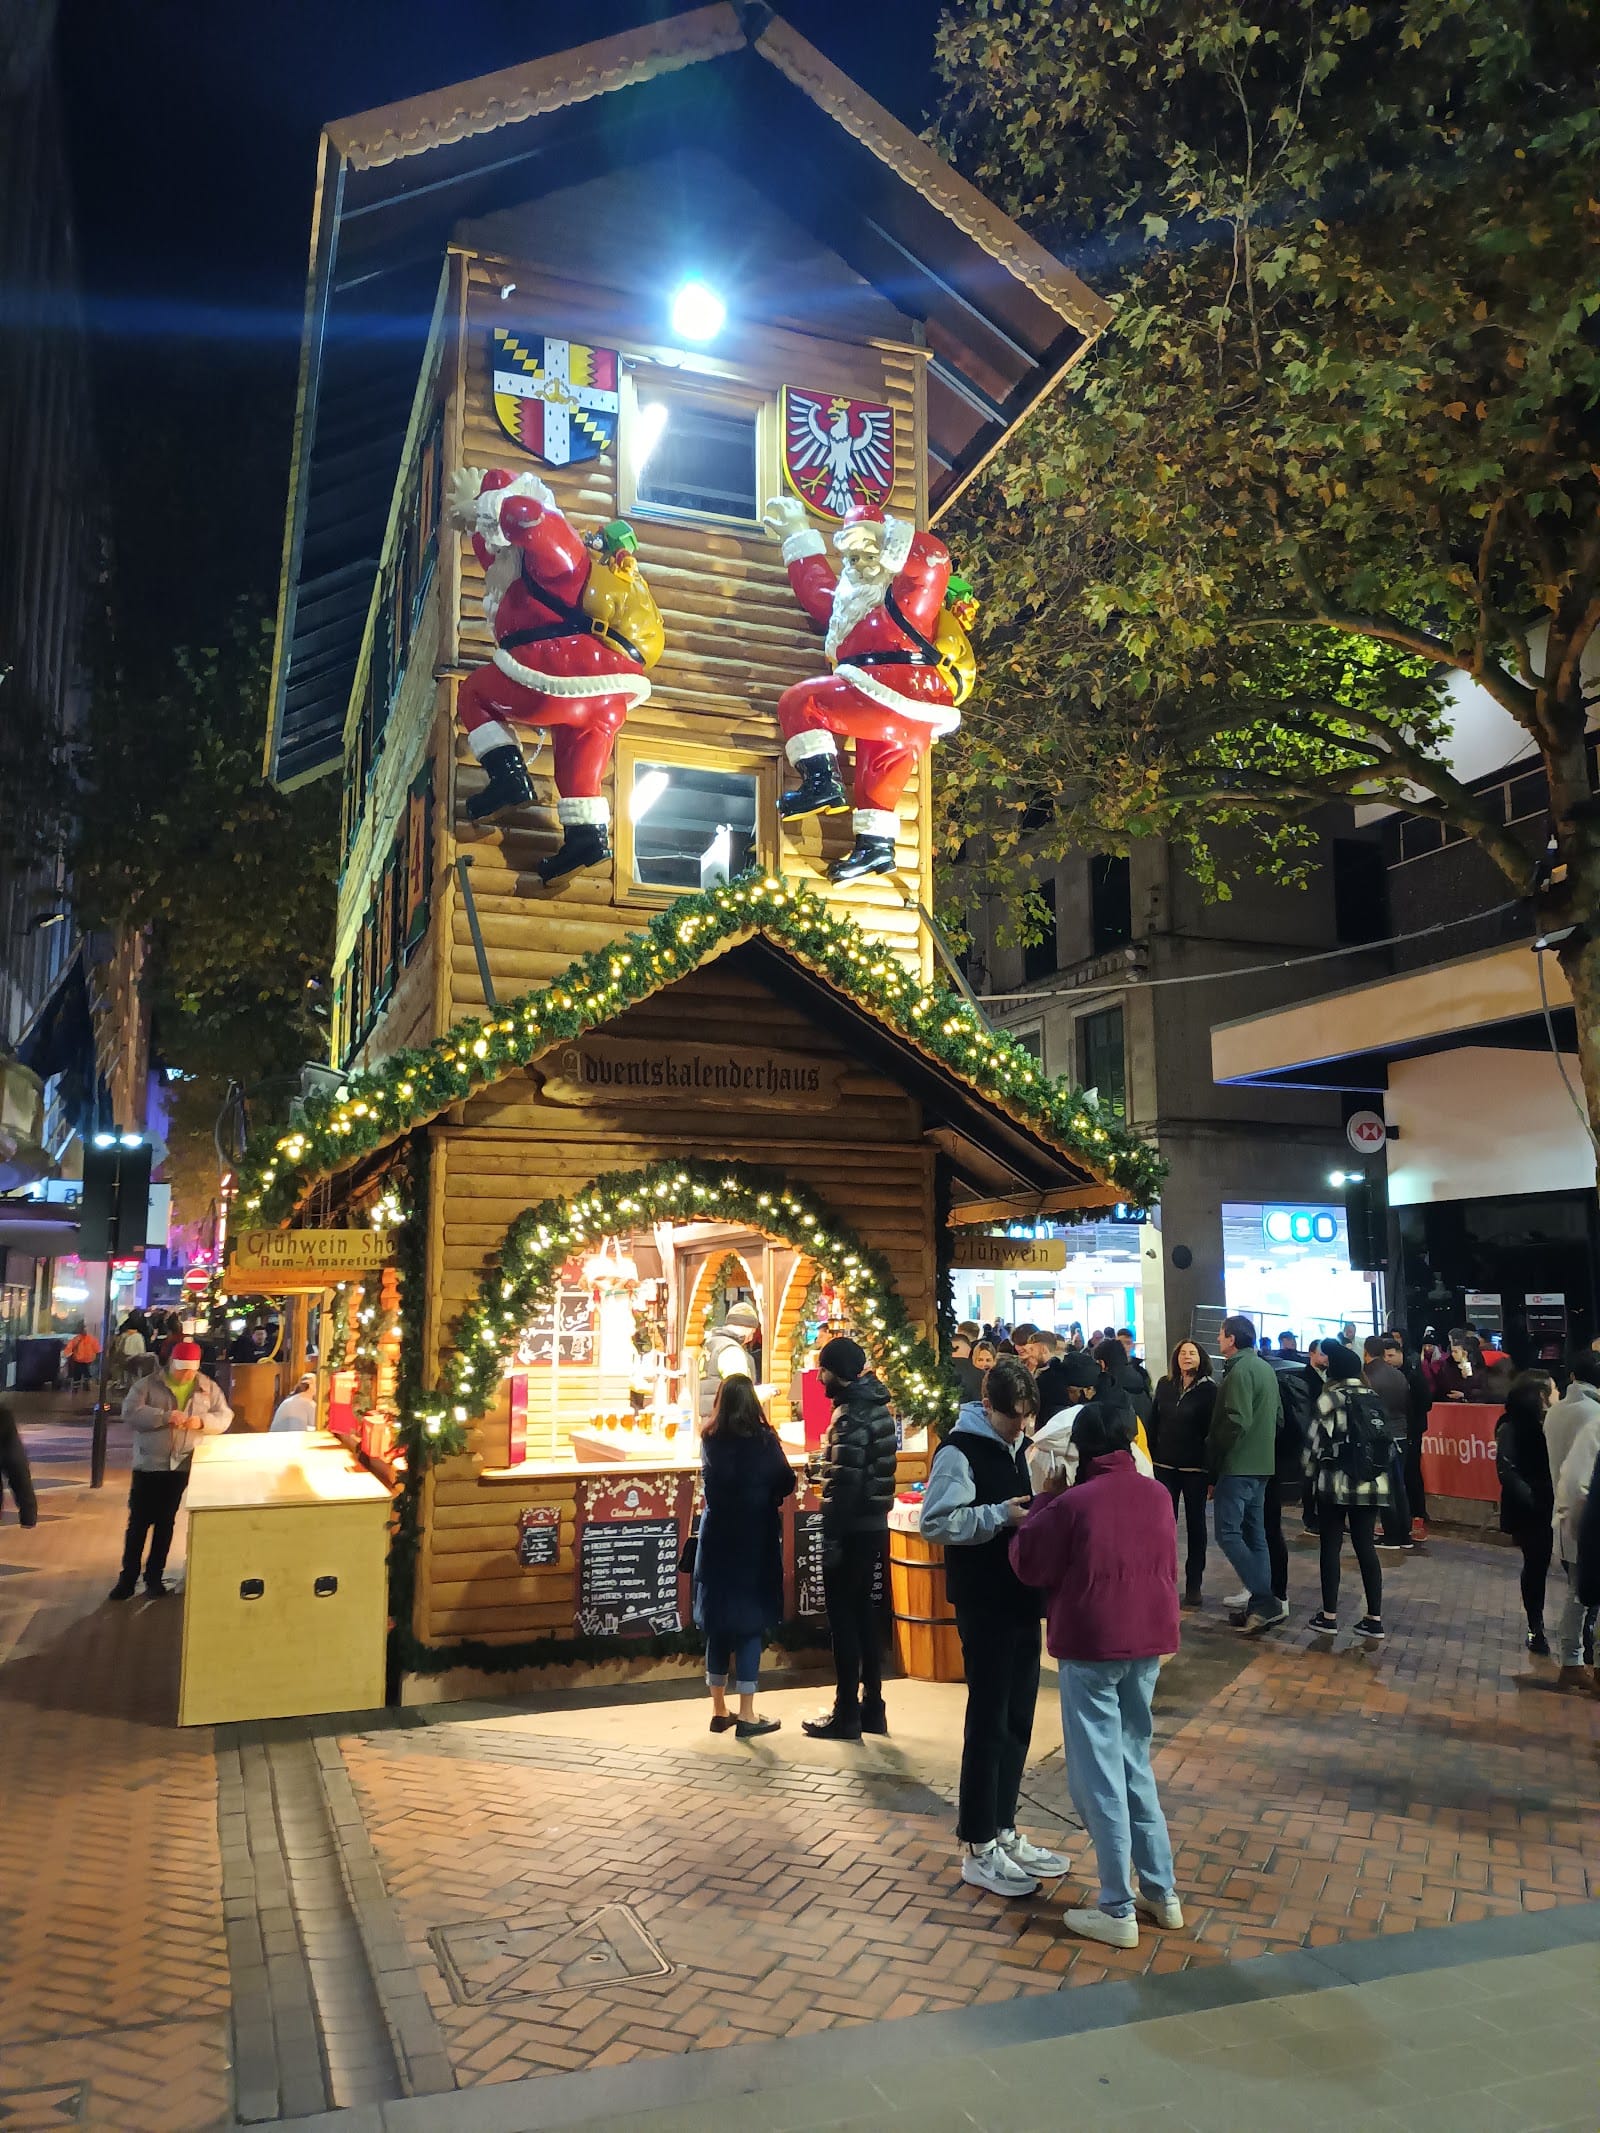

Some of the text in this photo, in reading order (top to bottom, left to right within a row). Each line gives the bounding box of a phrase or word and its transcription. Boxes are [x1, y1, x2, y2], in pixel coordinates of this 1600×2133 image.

[561, 1048, 821, 1095] Adventskalenderhaus
[247, 1231, 395, 1258] Glühwein Sho
[953, 1242, 1049, 1264] Glühwein
[1421, 1431, 1498, 1464] mingha
[657, 1550, 677, 1560] 6.00
[656, 1563, 677, 1574] 6.00
[657, 1575, 677, 1586] 6.00
[657, 1588, 677, 1599] 6.00
